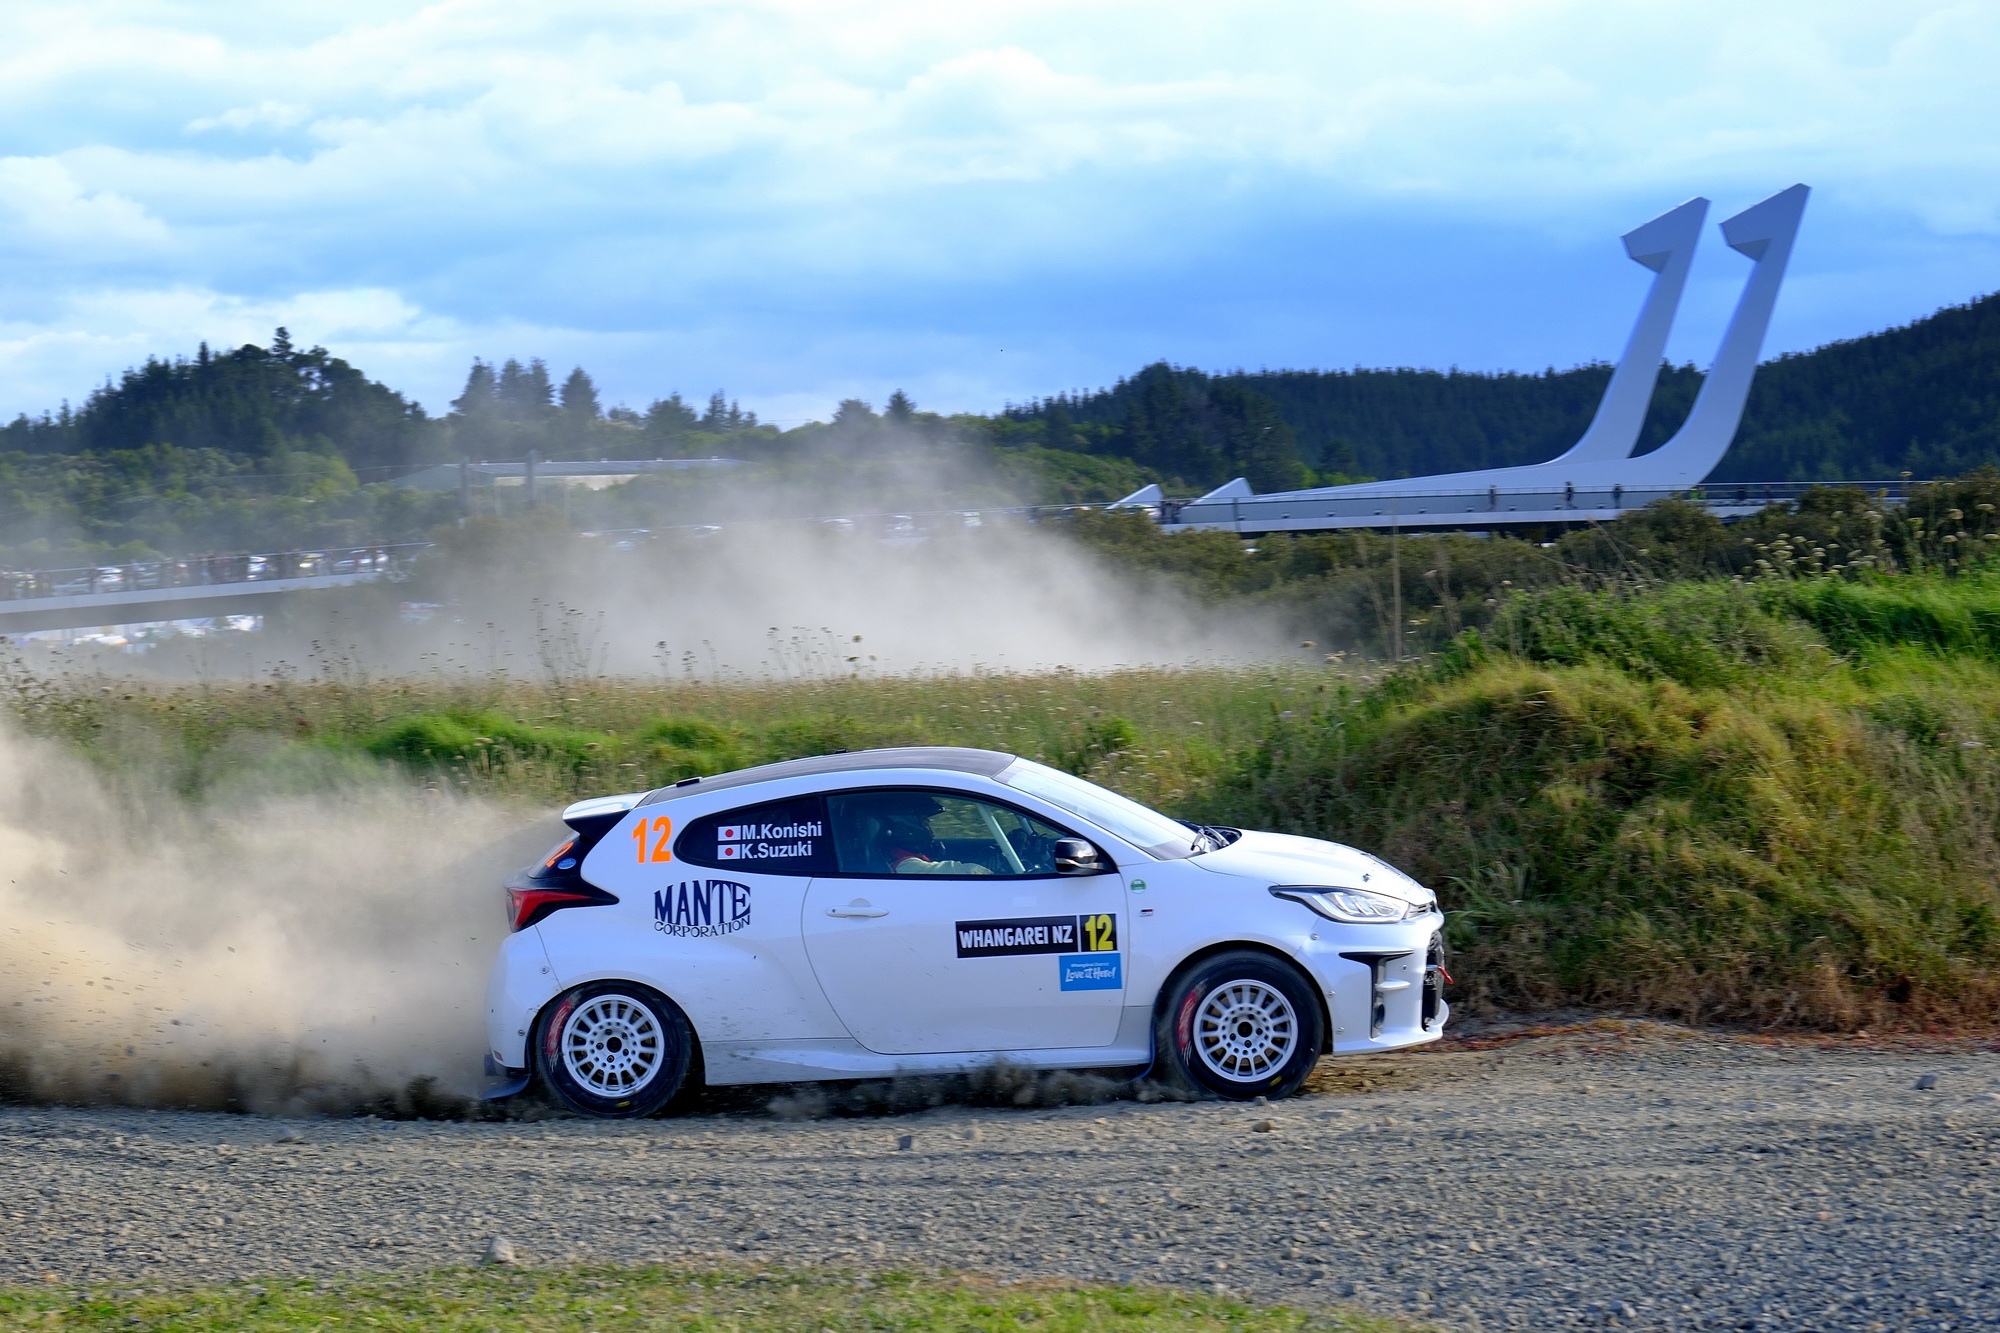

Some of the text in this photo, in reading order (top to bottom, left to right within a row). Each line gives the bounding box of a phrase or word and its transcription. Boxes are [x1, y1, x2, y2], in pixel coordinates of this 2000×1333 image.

[631, 816, 672, 863] 12
[741, 821, 822, 840] M.Konishi
[741, 841, 812, 859] K.Suzuki
[654, 879, 751, 927] MANTE
[654, 914, 751, 938] CORPORATION
[959, 914, 1114, 951] WHANGAREI NZ 12
[1065, 968, 1084, 982] Love
